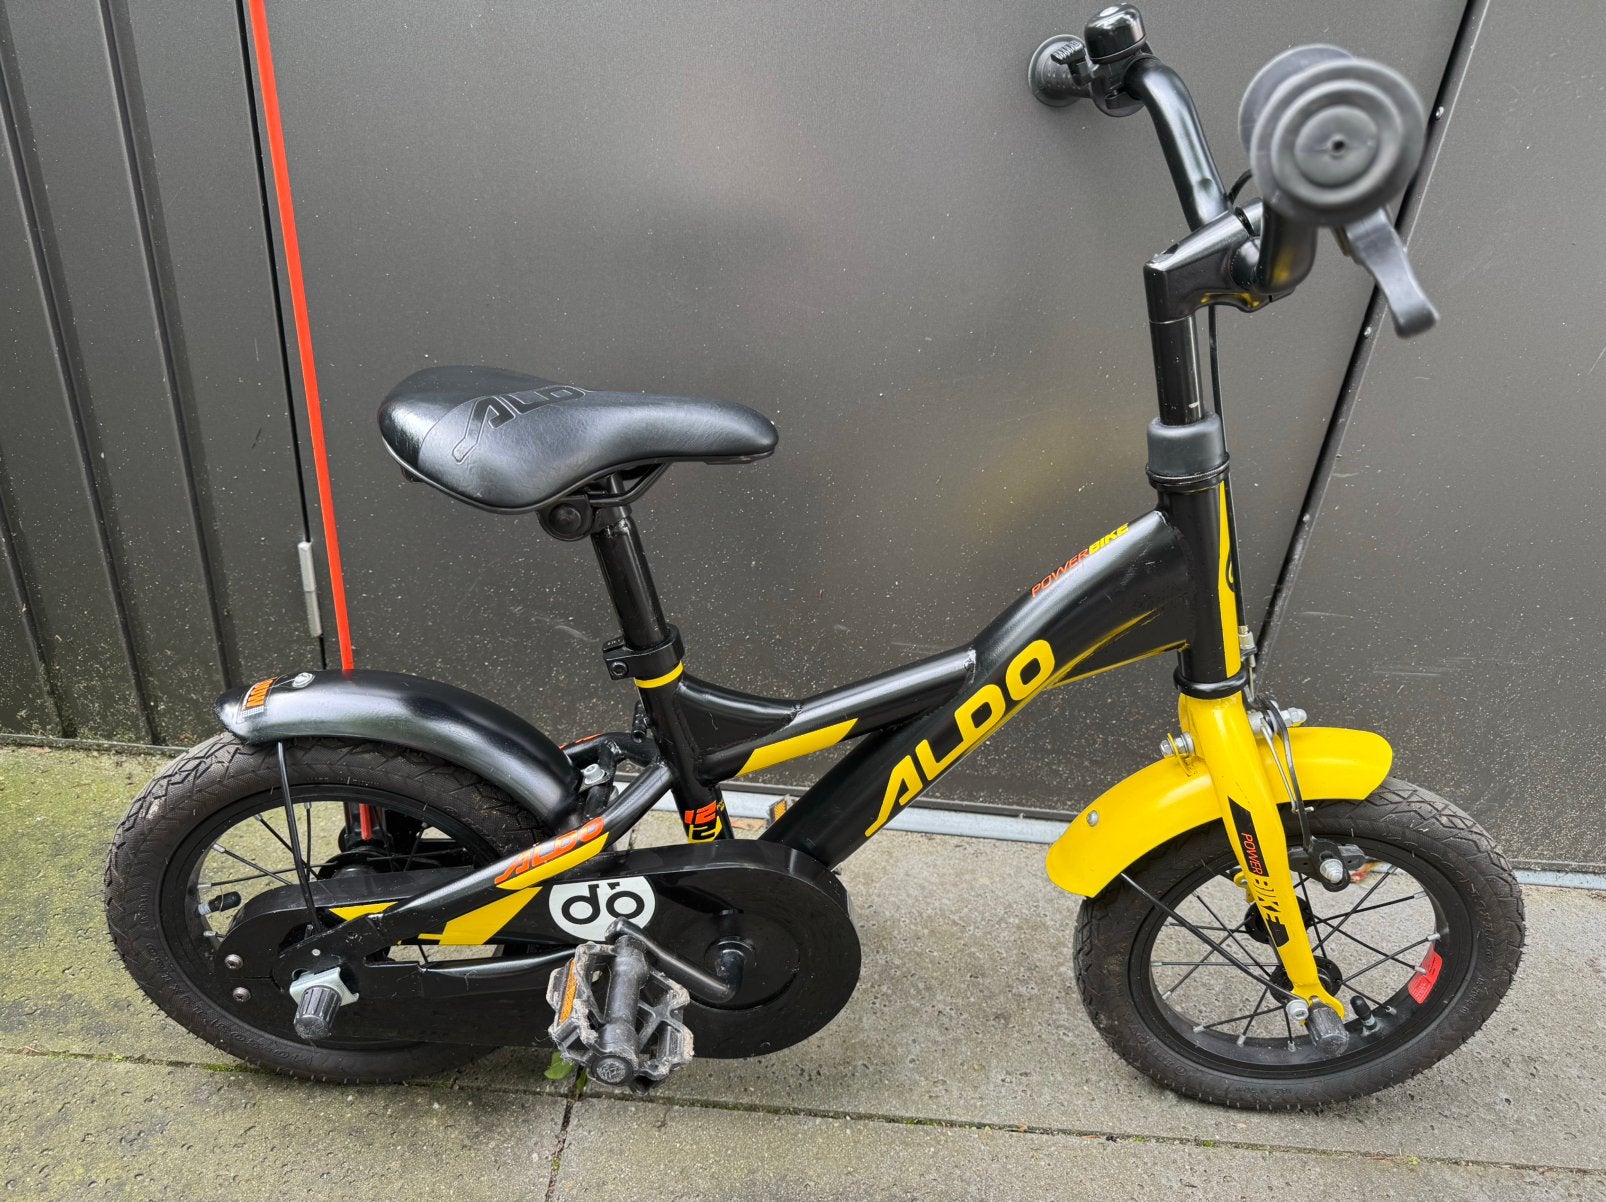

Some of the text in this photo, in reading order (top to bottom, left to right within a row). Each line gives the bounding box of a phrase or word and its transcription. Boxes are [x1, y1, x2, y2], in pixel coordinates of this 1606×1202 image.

[452, 386, 588, 464] ALD
[865, 639, 1056, 838] ALDO
[494, 816, 604, 885] ALDO
